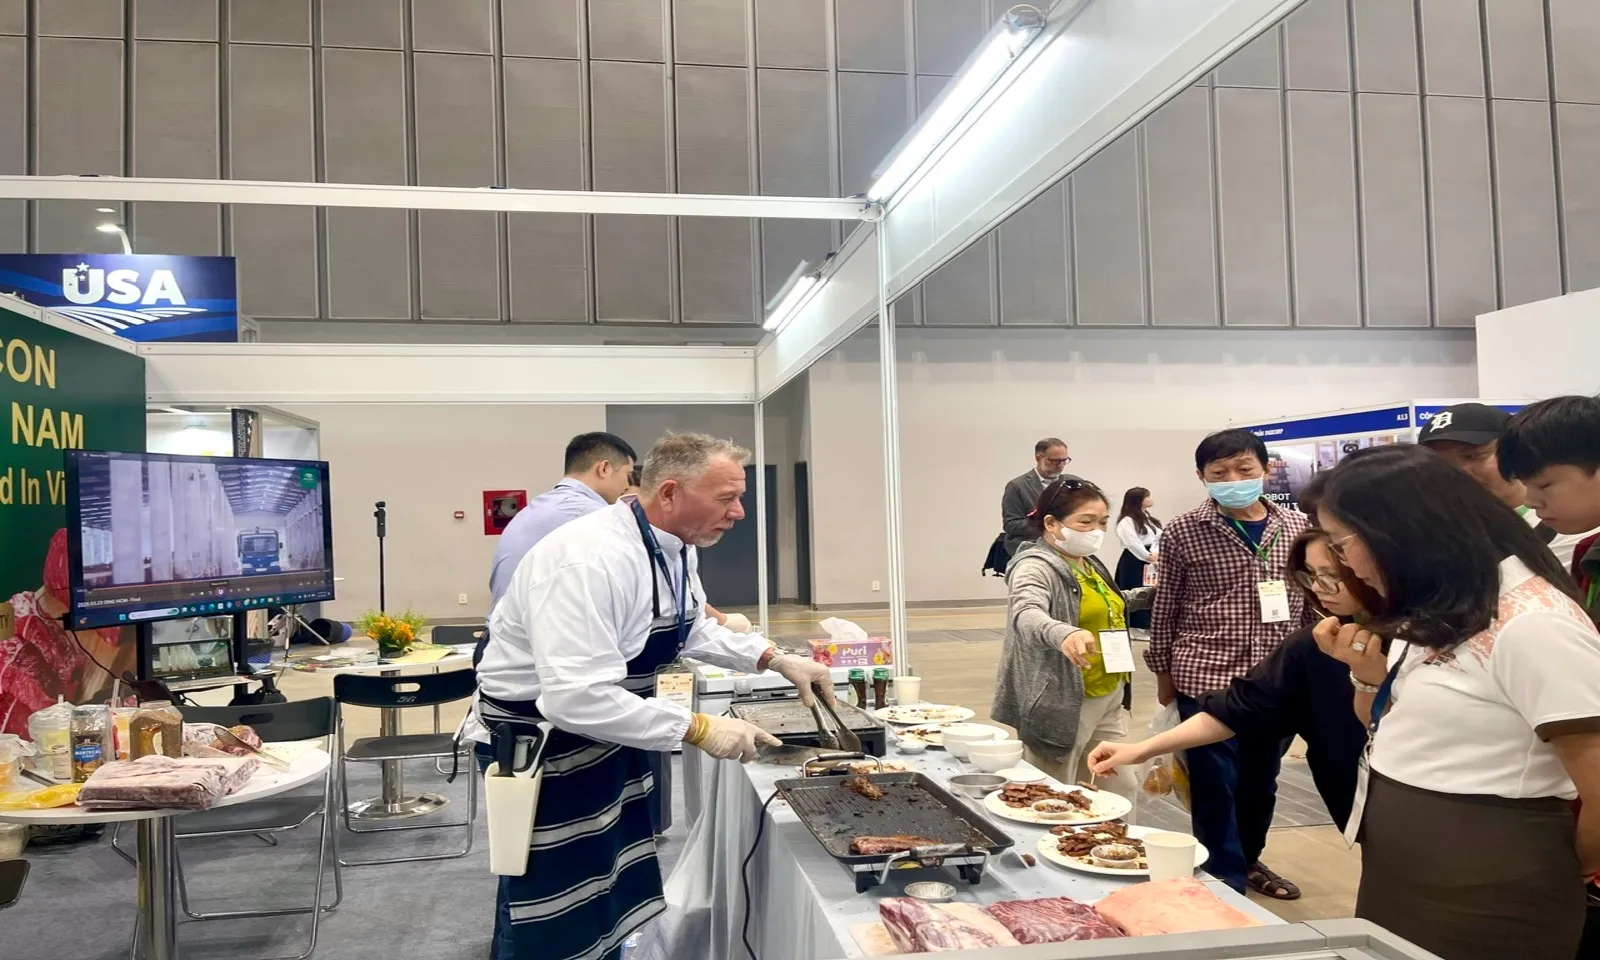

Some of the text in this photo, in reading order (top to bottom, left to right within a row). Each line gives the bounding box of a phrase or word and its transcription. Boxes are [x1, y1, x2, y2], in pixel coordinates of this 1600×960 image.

[62, 267, 187, 305] USA
[0, 338, 56, 389] ON
[12, 401, 84, 450] NAM
[21, 468, 40, 505] In
[1262, 493, 1290, 501] OBOT
[842, 645, 867, 656] Puri
